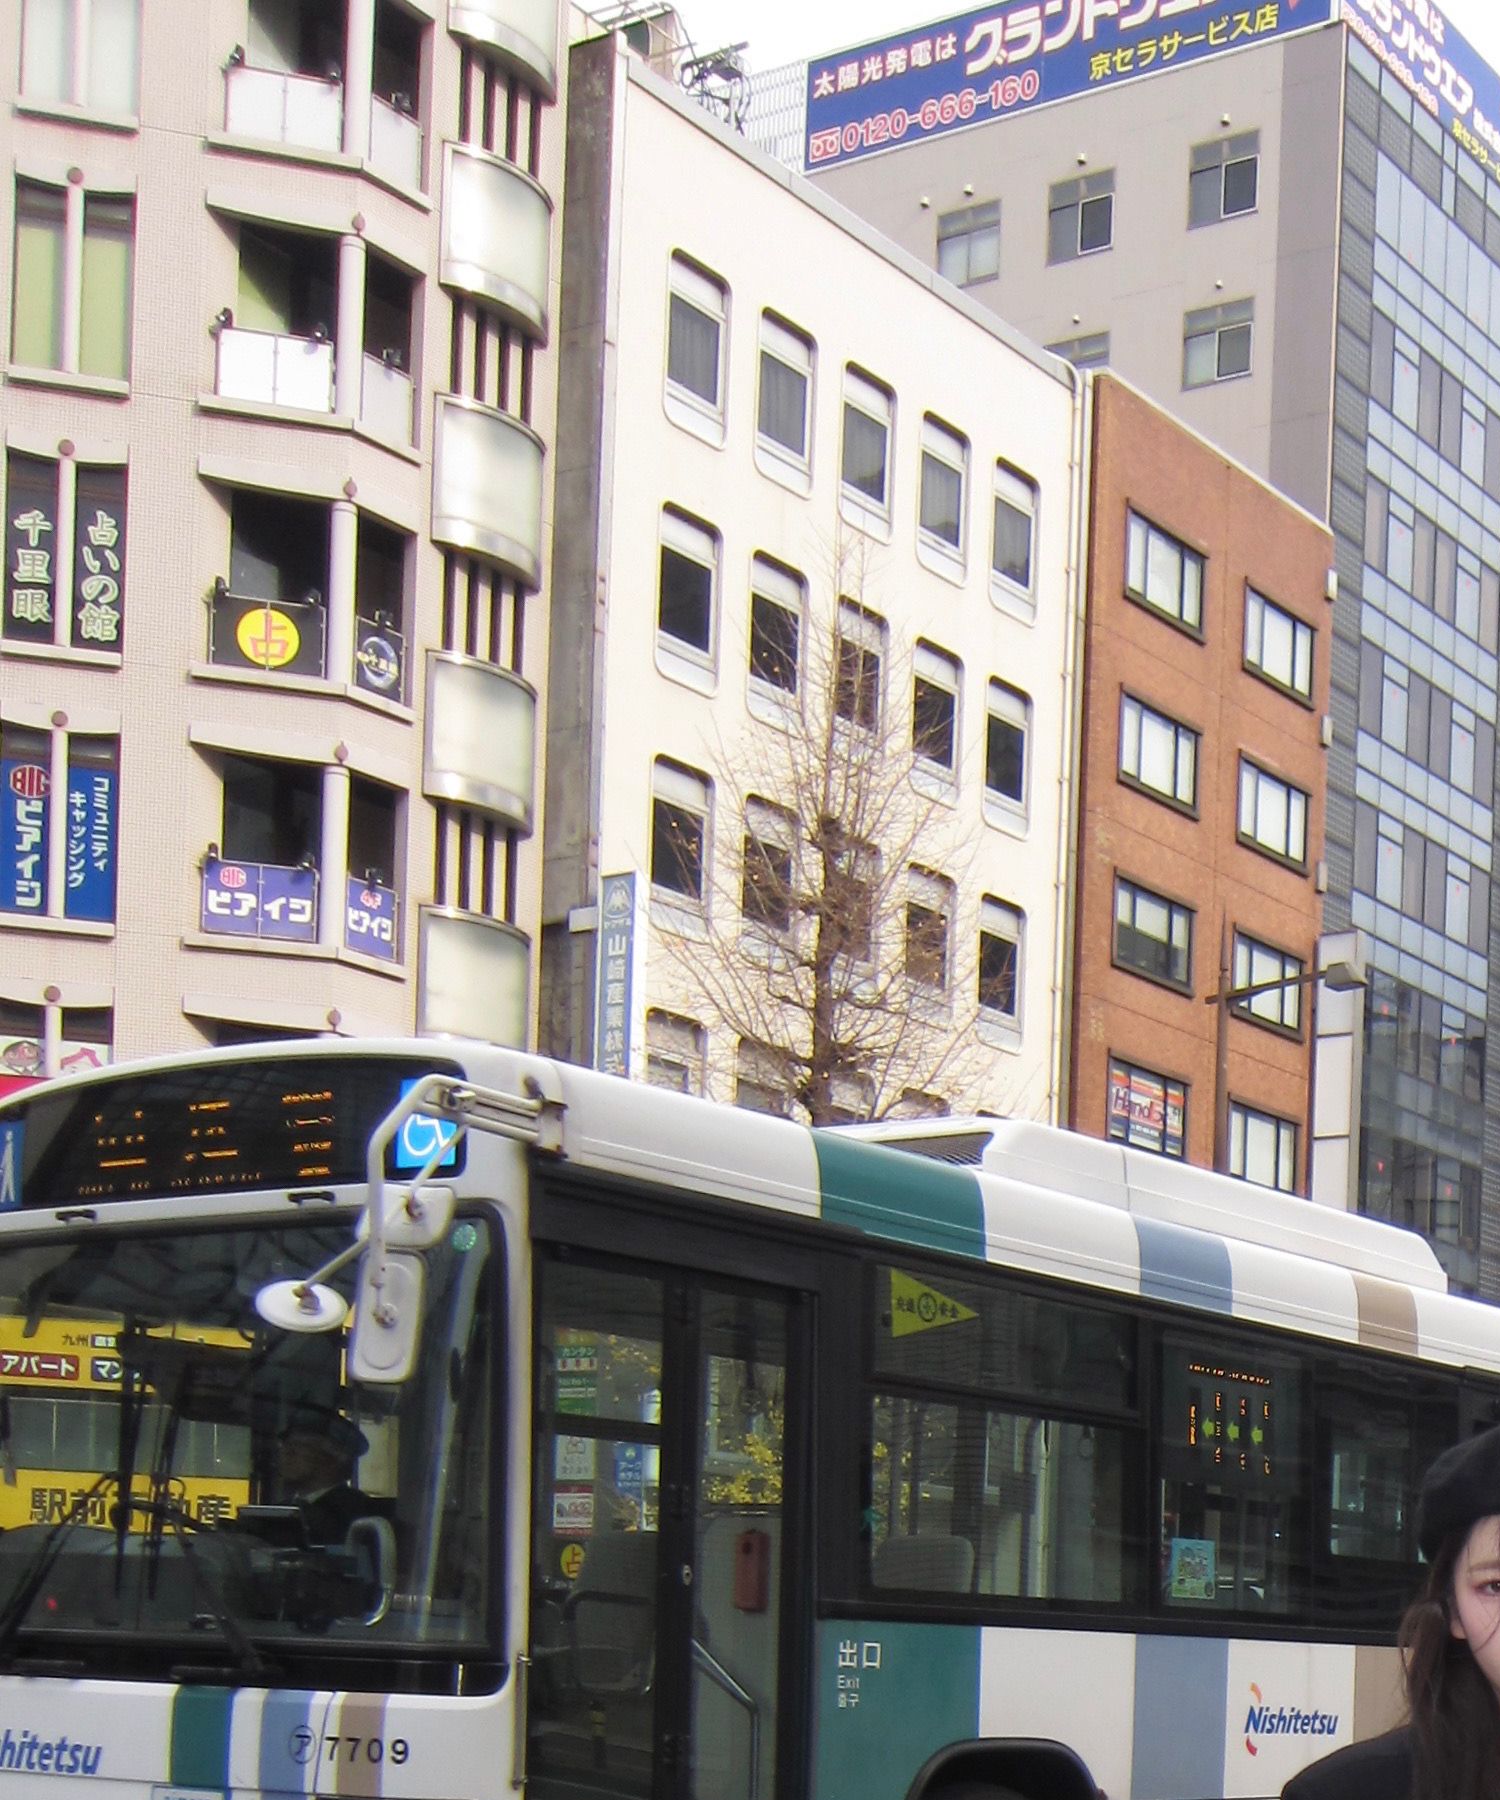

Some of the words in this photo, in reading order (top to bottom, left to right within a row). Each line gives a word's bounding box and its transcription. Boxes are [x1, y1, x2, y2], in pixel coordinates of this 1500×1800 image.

[813, 33, 957, 100] 太陽光発電は
[1088, 2, 1280, 82] 京セラサービス店
[842, 69, 1040, 152] 0120-666-160
[12, 510, 53, 624] 千里眼
[78, 510, 121, 642] 占いの館
[248, 609, 289, 659] 占
[68, 791, 87, 889] キャッシング
[91, 776, 110, 872] コミュニティ
[1, 1354, 77, 1378] アパート
[837, 1674, 860, 1689] Exit
[838, 1640, 881, 1669] 出口
[325, 1736, 409, 1765] 7709
[1244, 1705, 1339, 1735] Nishitetsu
